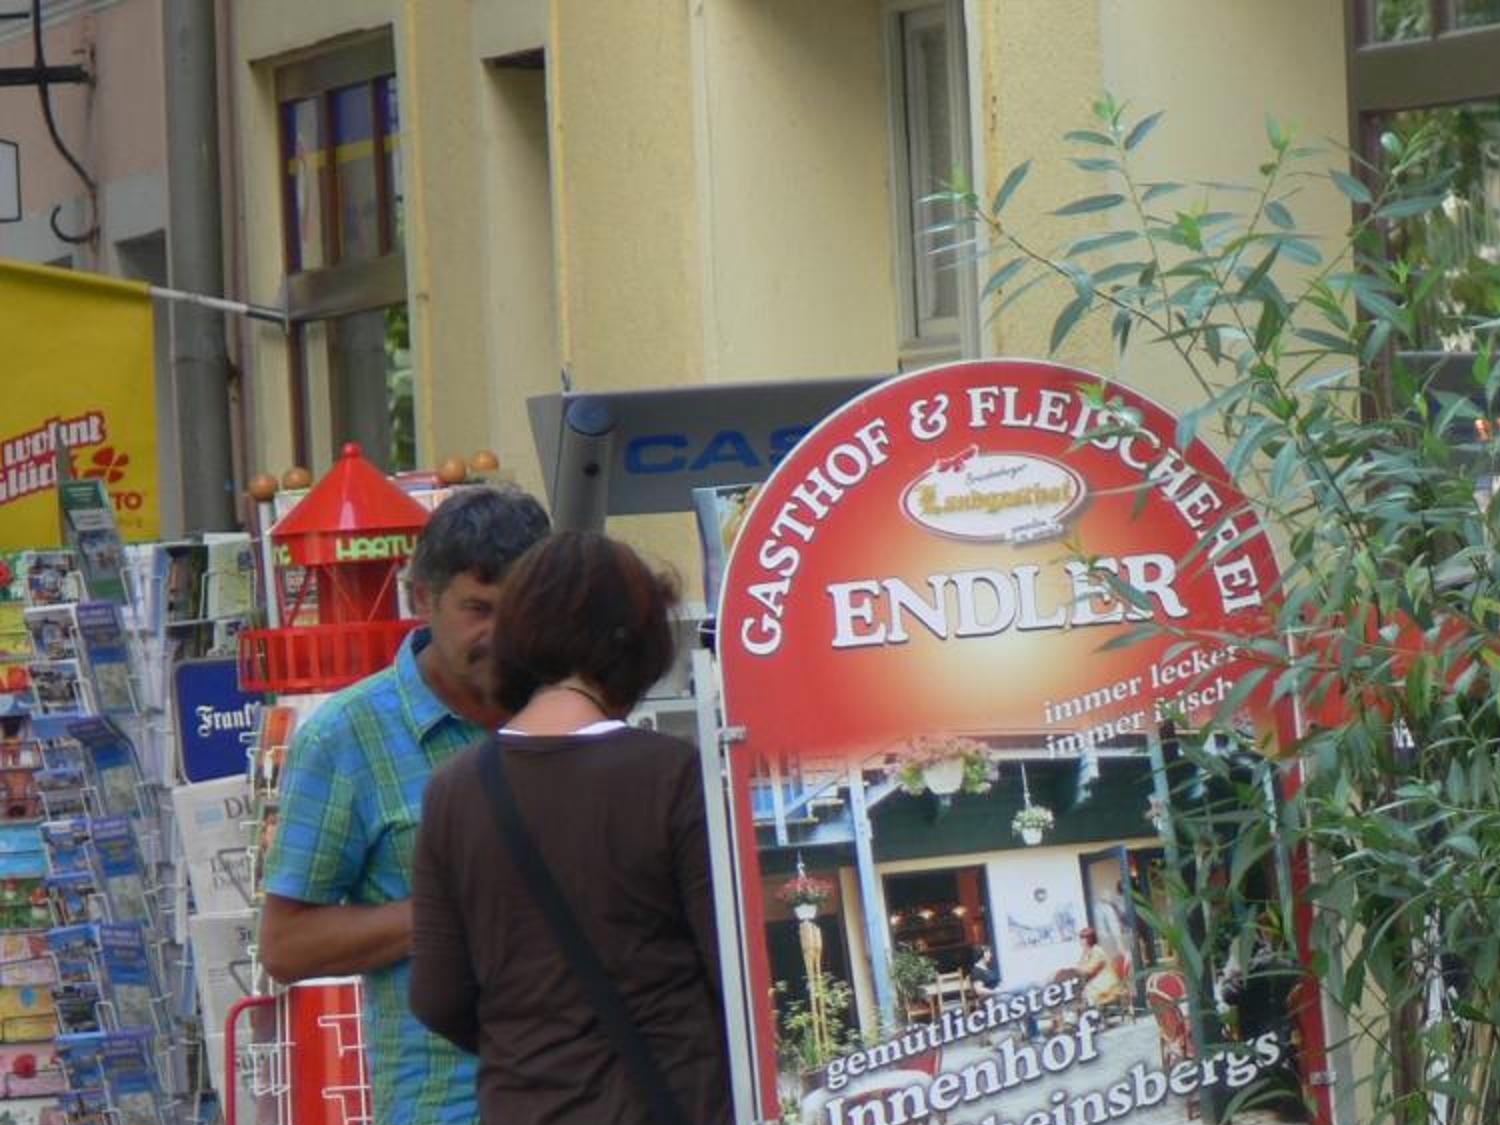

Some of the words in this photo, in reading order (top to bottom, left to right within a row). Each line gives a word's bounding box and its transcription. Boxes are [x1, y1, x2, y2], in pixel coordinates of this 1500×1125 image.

[741, 417, 889, 655] GASTHOF
[909, 394, 949, 440] &
[827, 553, 1189, 649] ENDLER
[1043, 675, 1142, 724] immer
[1045, 710, 1145, 760] immer
[825, 976, 1080, 1090] gemütlichster
